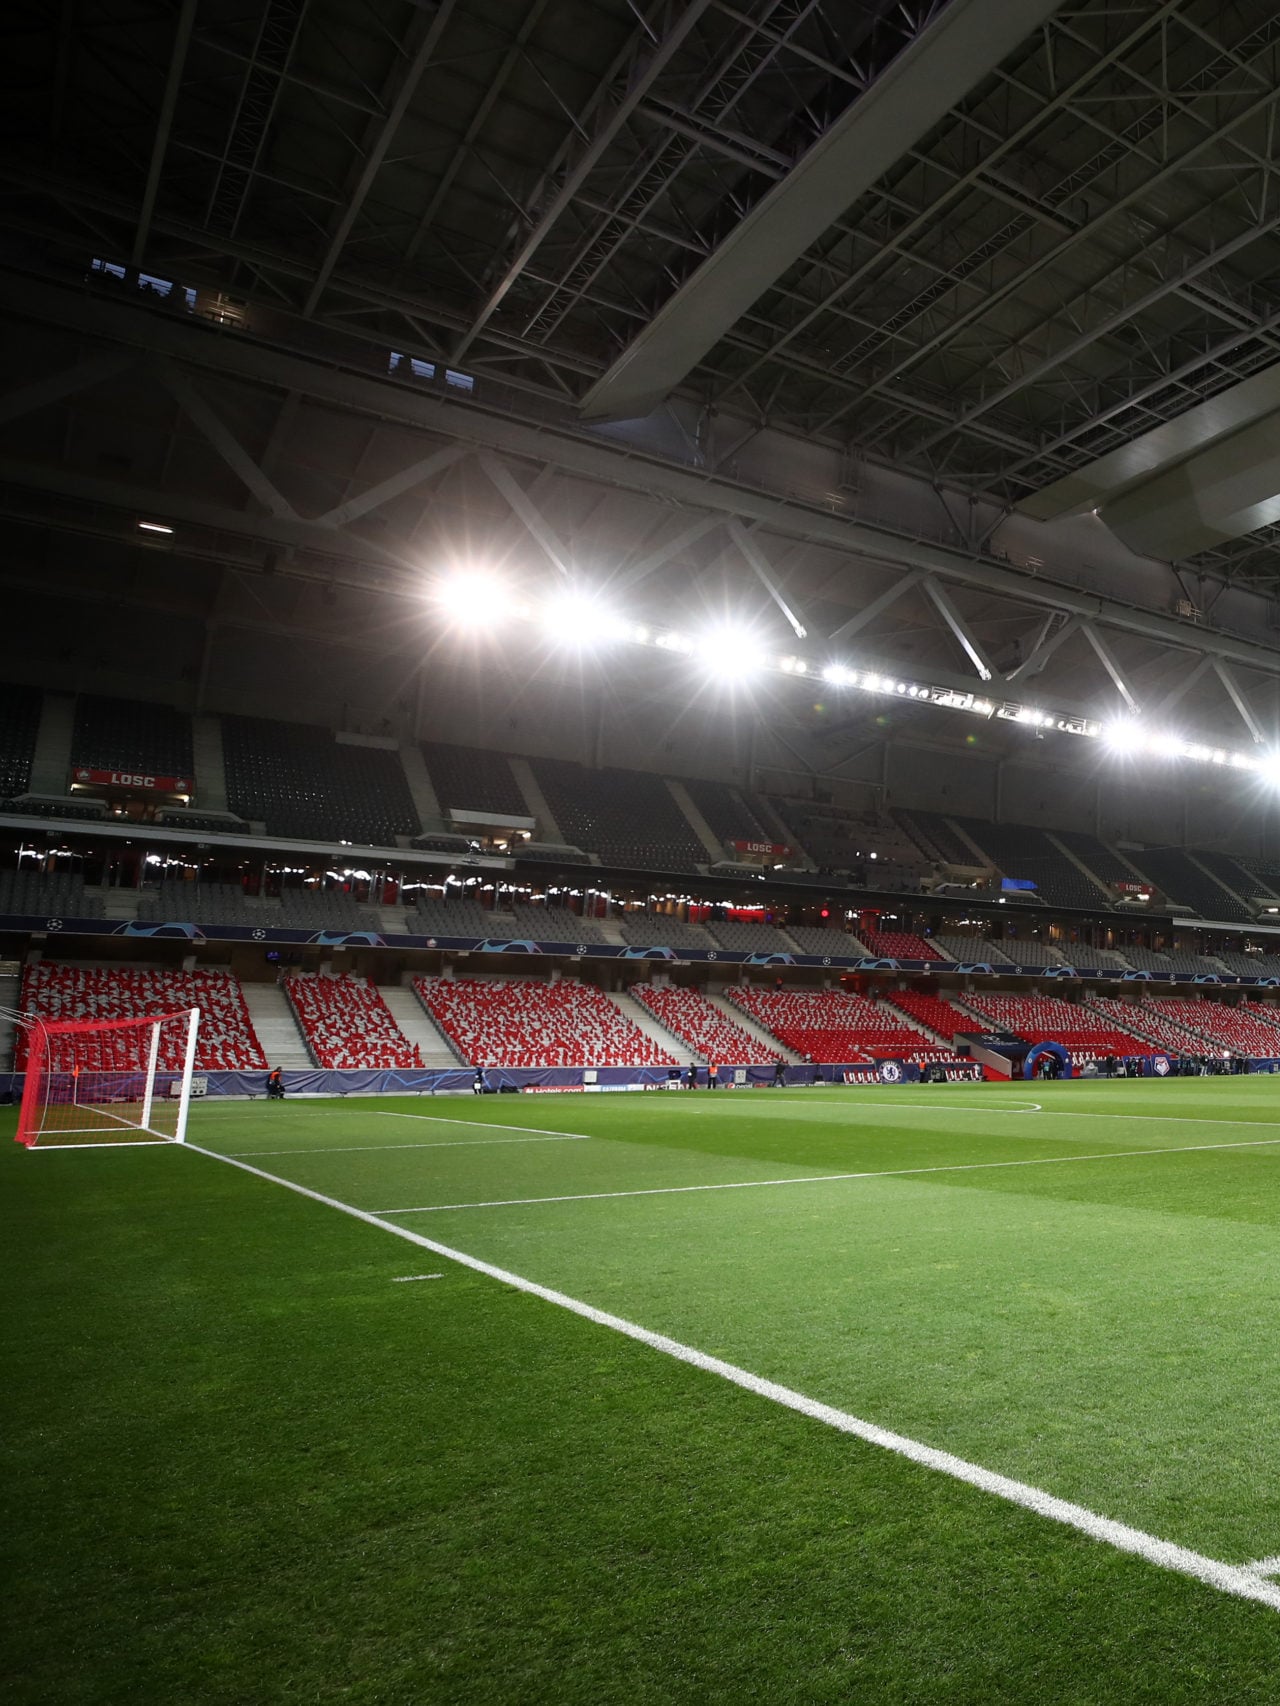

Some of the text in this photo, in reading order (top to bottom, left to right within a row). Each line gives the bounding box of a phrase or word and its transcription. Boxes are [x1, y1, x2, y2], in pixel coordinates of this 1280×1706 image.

[111, 773, 156, 788] LOSC
[747, 843, 772, 854] LOSC
[1126, 884, 1142, 892] LOSC
